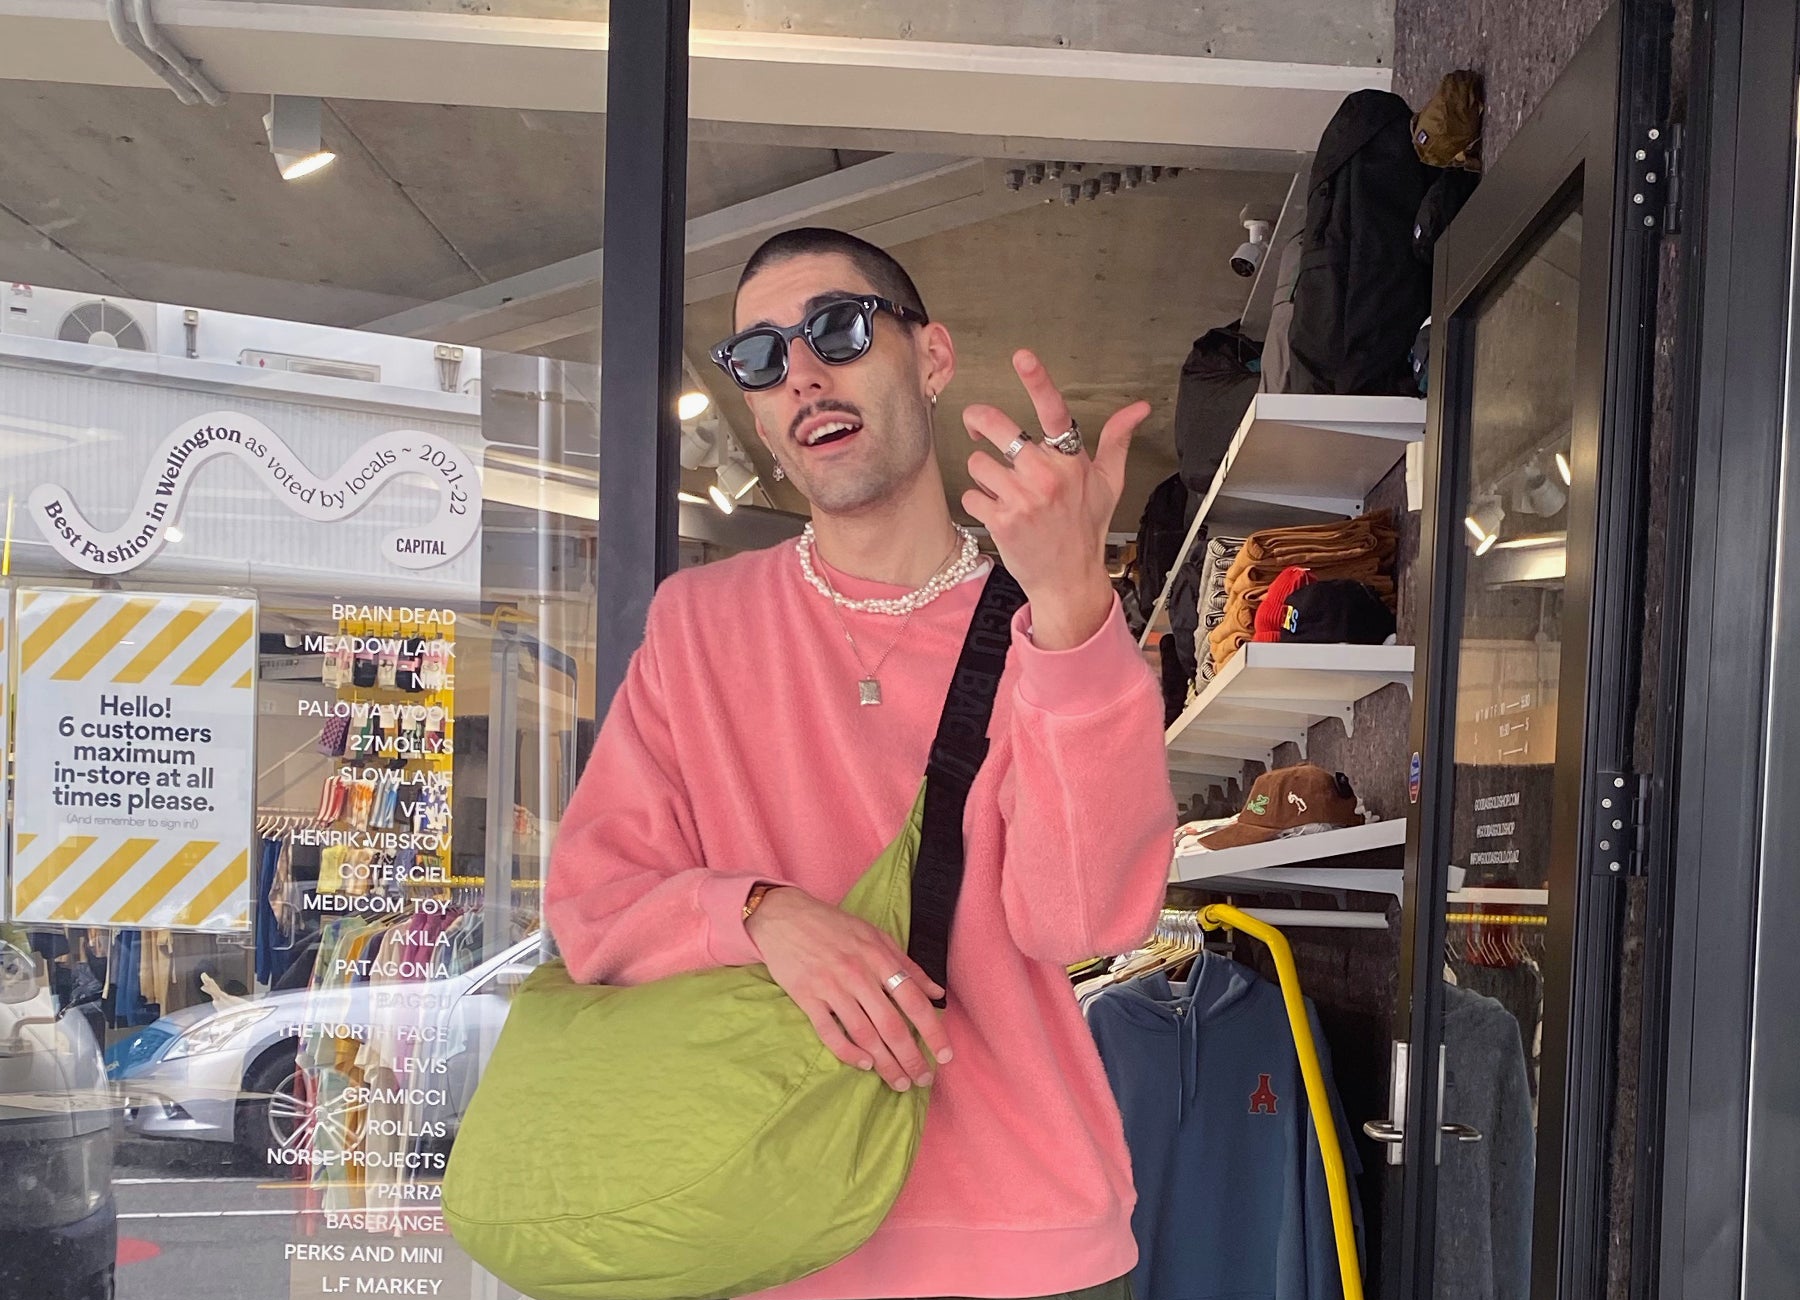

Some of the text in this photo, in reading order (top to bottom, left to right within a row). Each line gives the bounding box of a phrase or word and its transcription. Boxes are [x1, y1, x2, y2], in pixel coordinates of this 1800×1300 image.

[244, 436, 267, 458] as
[156, 425, 242, 497] Wellington
[268, 457, 316, 504] voted
[345, 447, 396, 497] locals
[418, 445, 467, 516] 2021-22
[320, 488, 346, 509] by
[44, 499, 82, 547] Best
[145, 502, 168, 523] in
[80, 524, 158, 564] Fashion
[396, 538, 446, 555] CAPITAL
[332, 604, 456, 625] BRAIN DEAD
[304, 635, 456, 658] MEADOWLARK
[100, 695, 172, 718] Hello!
[298, 700, 455, 723] PALOMA WOOL
[59, 717, 212, 743] 6 customers
[73, 742, 195, 765] maximum
[54, 762, 214, 789] in-store at all
[52, 786, 215, 815] times please.
[66, 813, 91, 825] (And
[94, 815, 146, 827] remember
[148, 818, 159, 828] to
[160, 819, 181, 830] sign
[291, 829, 452, 851] HENRIK VIBSKOV
[339, 863, 451, 883] COTE&CIEL
[303, 894, 451, 915] MEDICOM TOY
[390, 930, 450, 947] AKILA
[335, 960, 450, 979] PATAGONIA
[376, 992, 451, 1010] BAGGU
[279, 1023, 448, 1043] THE NORTH FACE
[392, 1057, 447, 1074] LEVIS
[342, 1087, 446, 1106] GRAMICCI
[369, 1120, 446, 1138] ROLLAS
[267, 1148, 445, 1169] NORSE PROJECTS
[378, 1183, 442, 1201] PARRA
[326, 1214, 443, 1232] BASERANGE
[284, 1244, 443, 1264] PERKS AND MINI
[322, 1276, 443, 1295] L.F MARKEY
